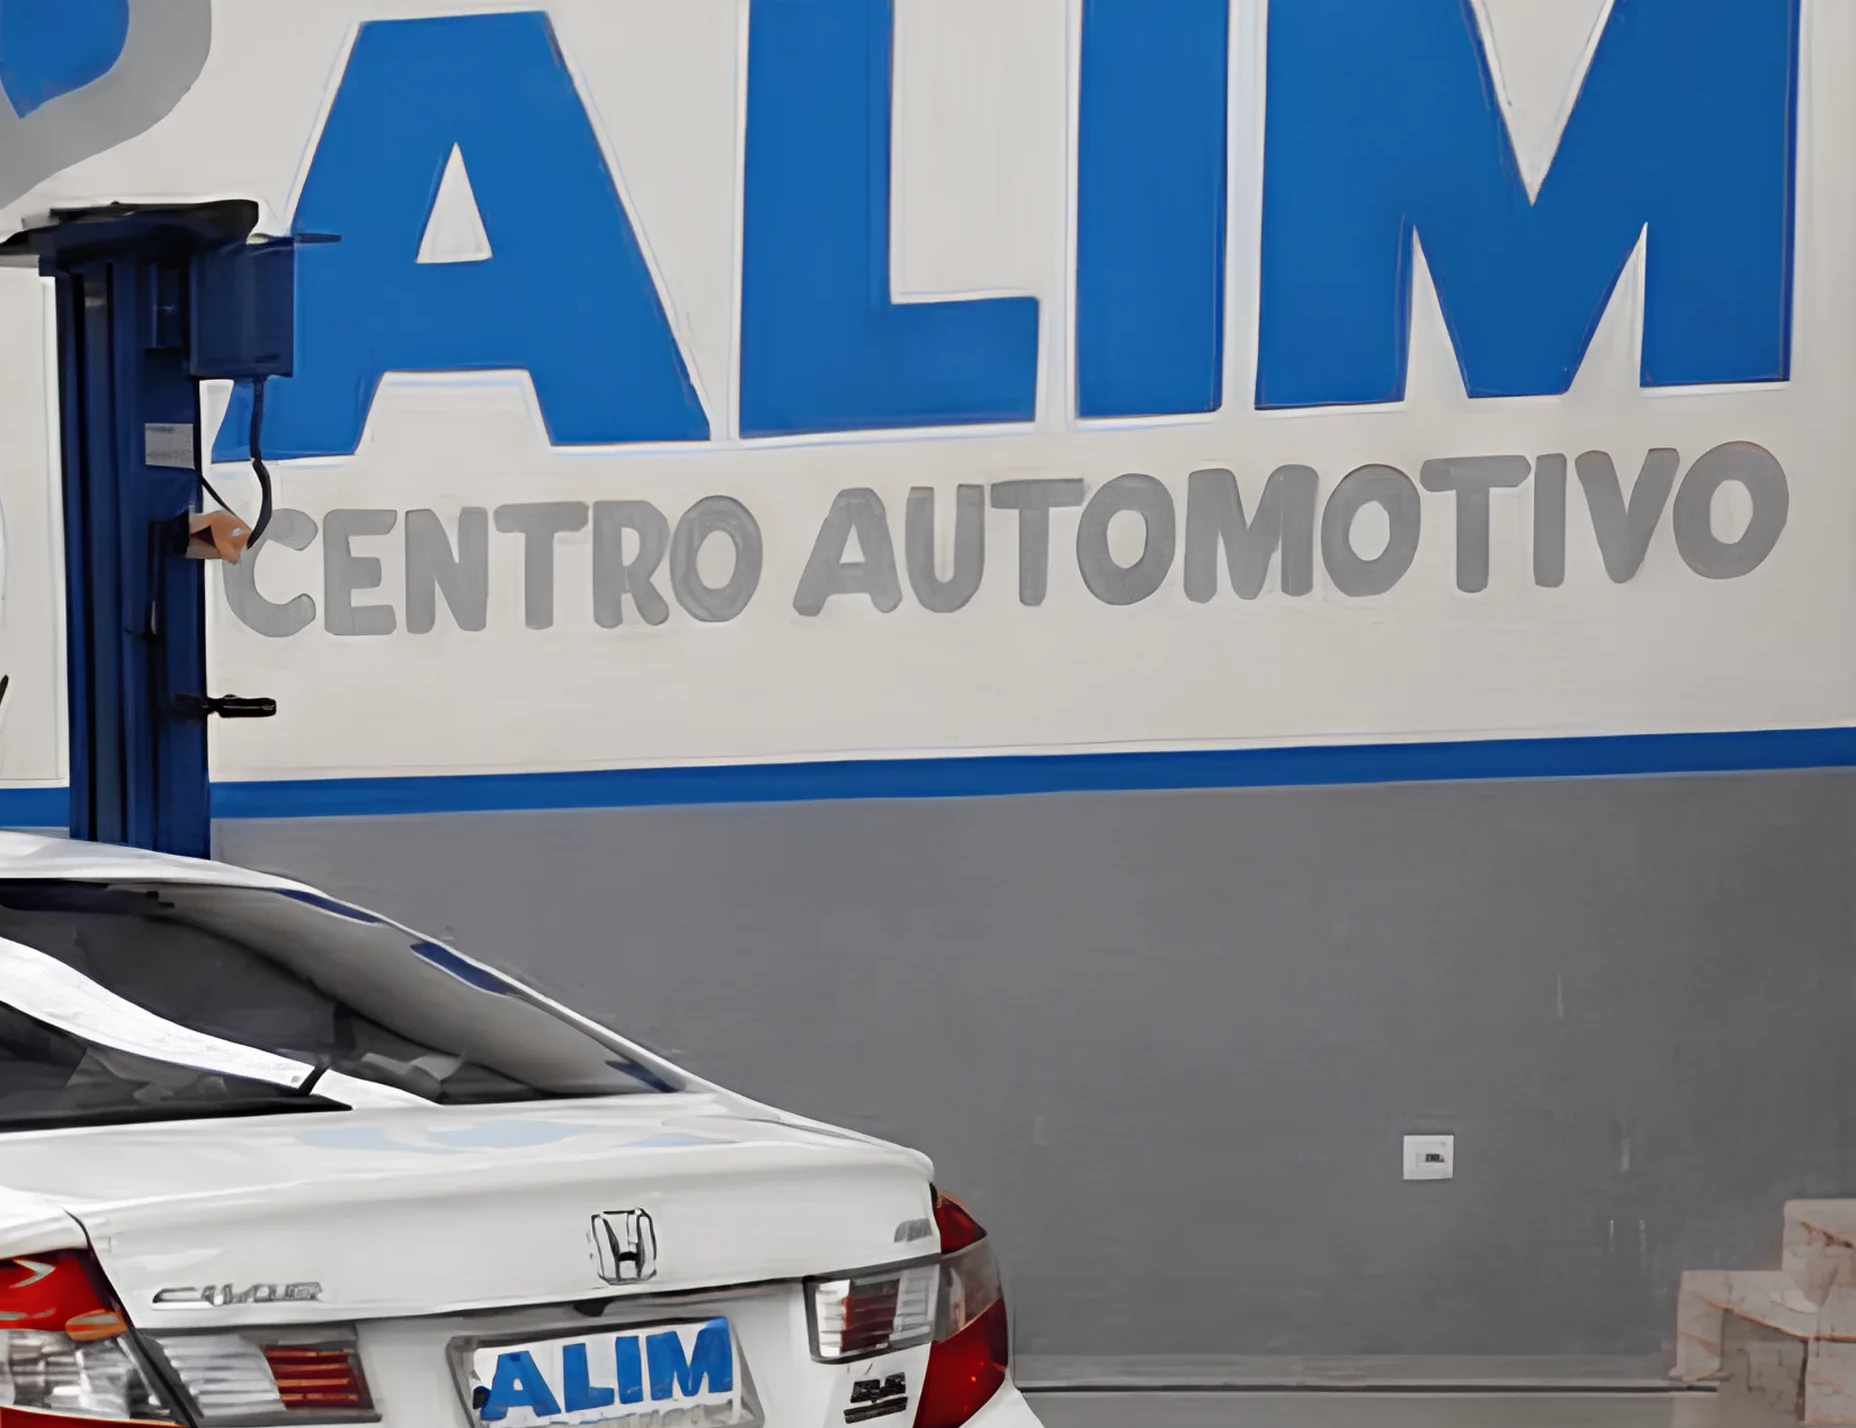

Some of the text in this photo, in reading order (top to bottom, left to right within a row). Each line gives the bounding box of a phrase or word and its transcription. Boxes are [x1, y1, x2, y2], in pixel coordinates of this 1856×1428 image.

[222, 440, 1790, 638] CENTRO AUTOMOTIVO
[478, 1315, 734, 1422] ALIM
